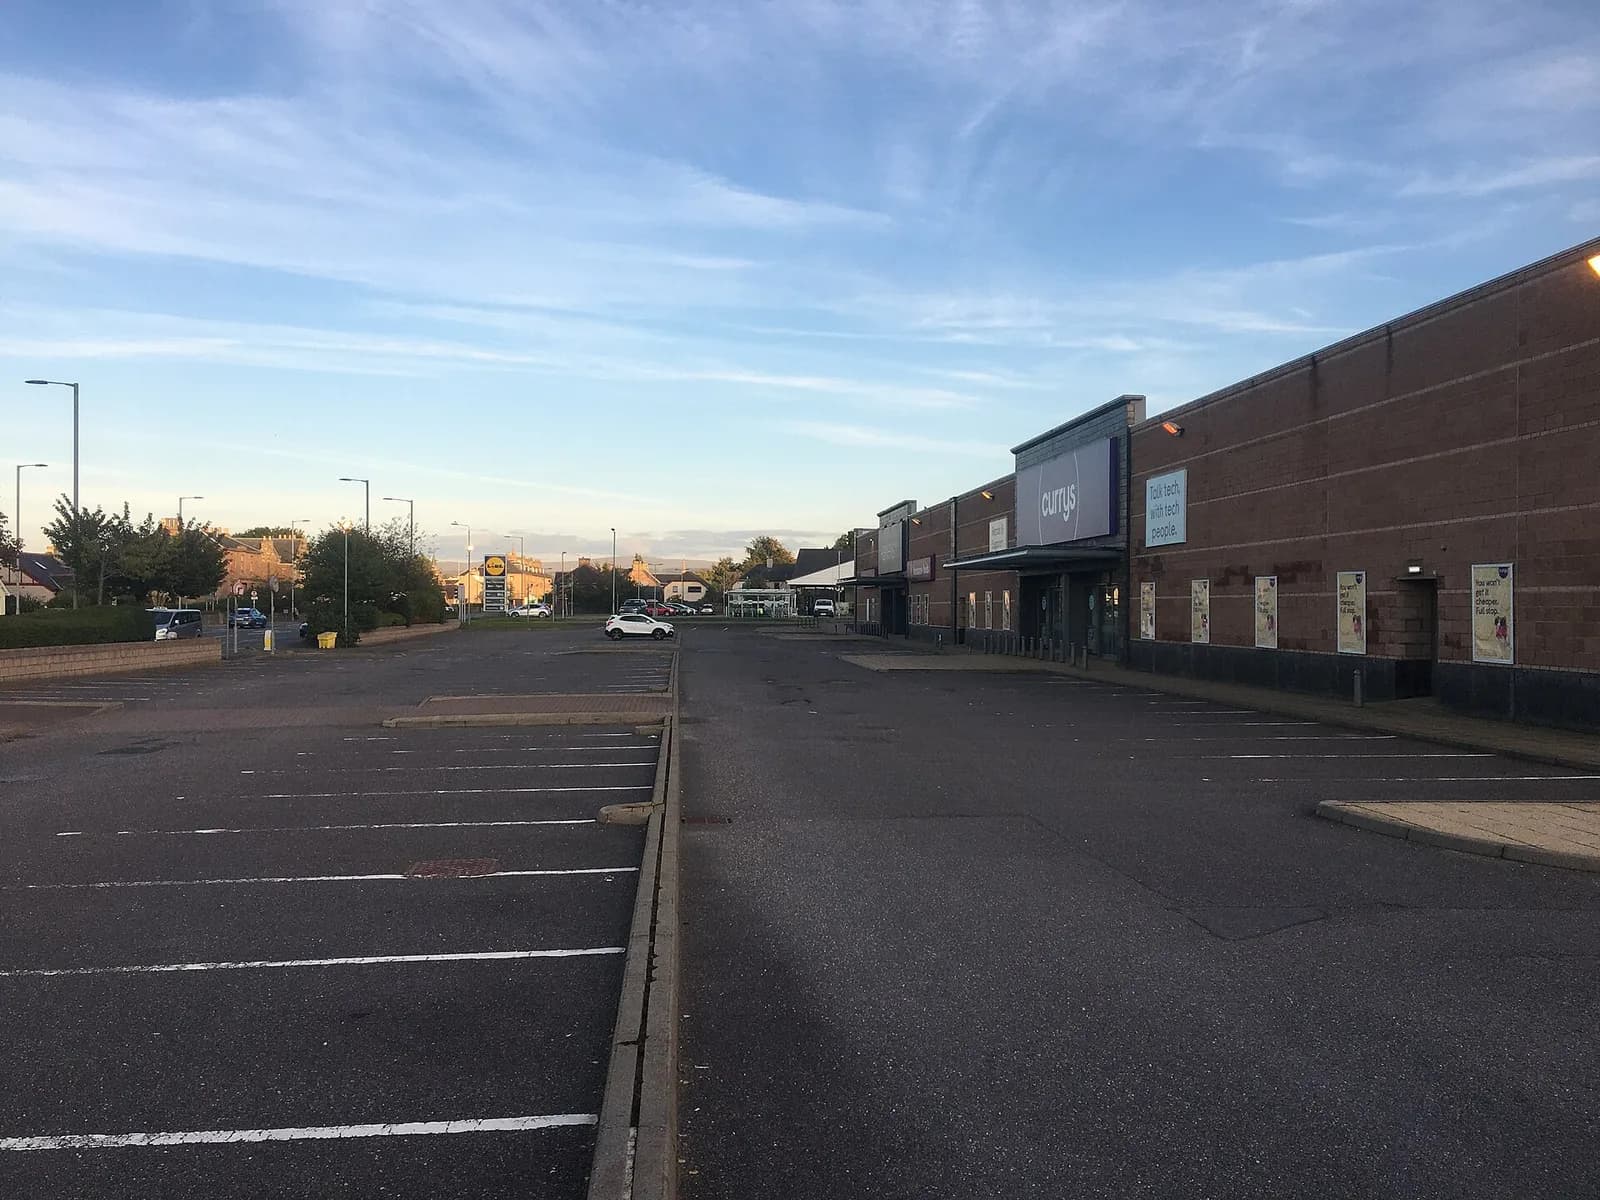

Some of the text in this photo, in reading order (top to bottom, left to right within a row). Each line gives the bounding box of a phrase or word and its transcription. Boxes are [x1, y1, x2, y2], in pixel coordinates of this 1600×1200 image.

[1150, 484, 1163, 500] Talk
[1041, 483, 1076, 522] currys
[1164, 500, 1180, 517] tech
